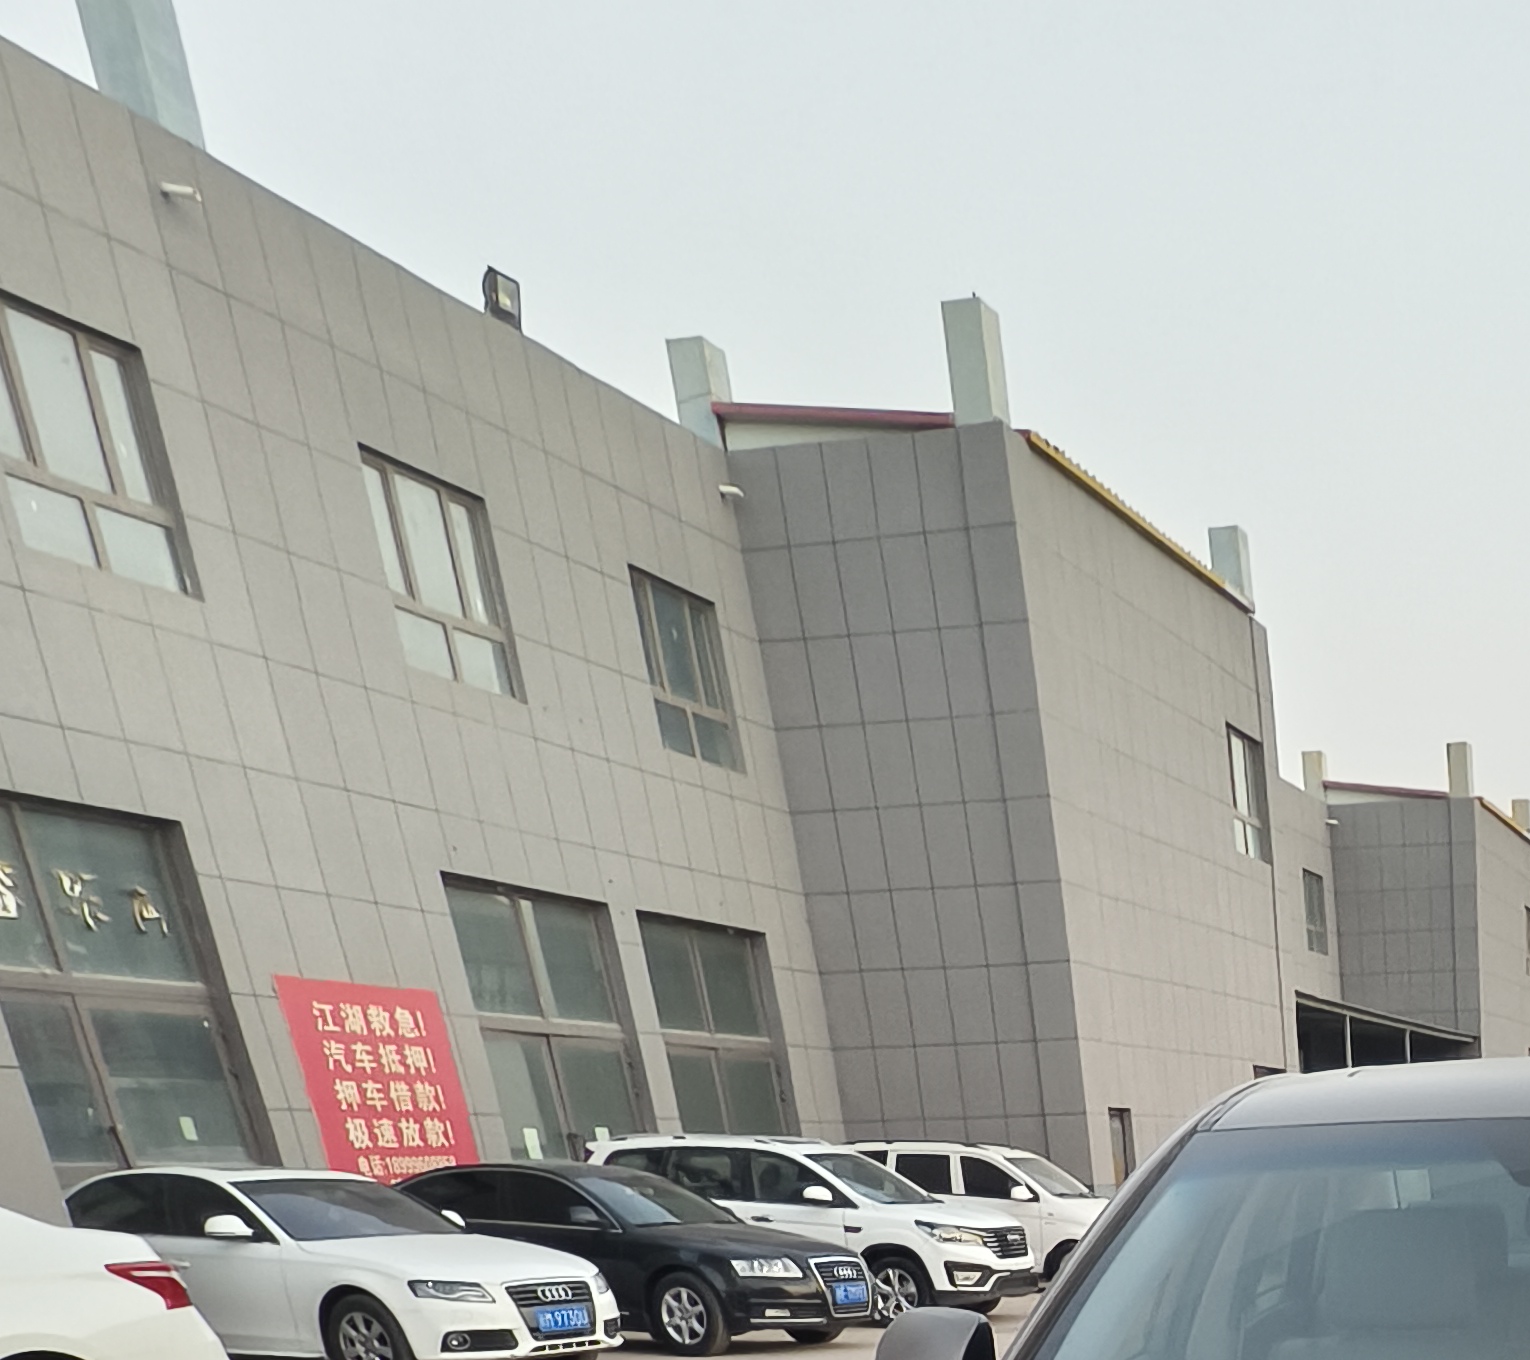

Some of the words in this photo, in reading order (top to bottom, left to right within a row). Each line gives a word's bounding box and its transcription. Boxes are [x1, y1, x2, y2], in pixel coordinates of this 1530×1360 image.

[312, 1000, 427, 1038] 江湖救急!
[323, 1039, 437, 1075] 汽车抵押!
[333, 1078, 447, 1112] 押车借款!
[345, 1117, 456, 1149] 极速放款!
